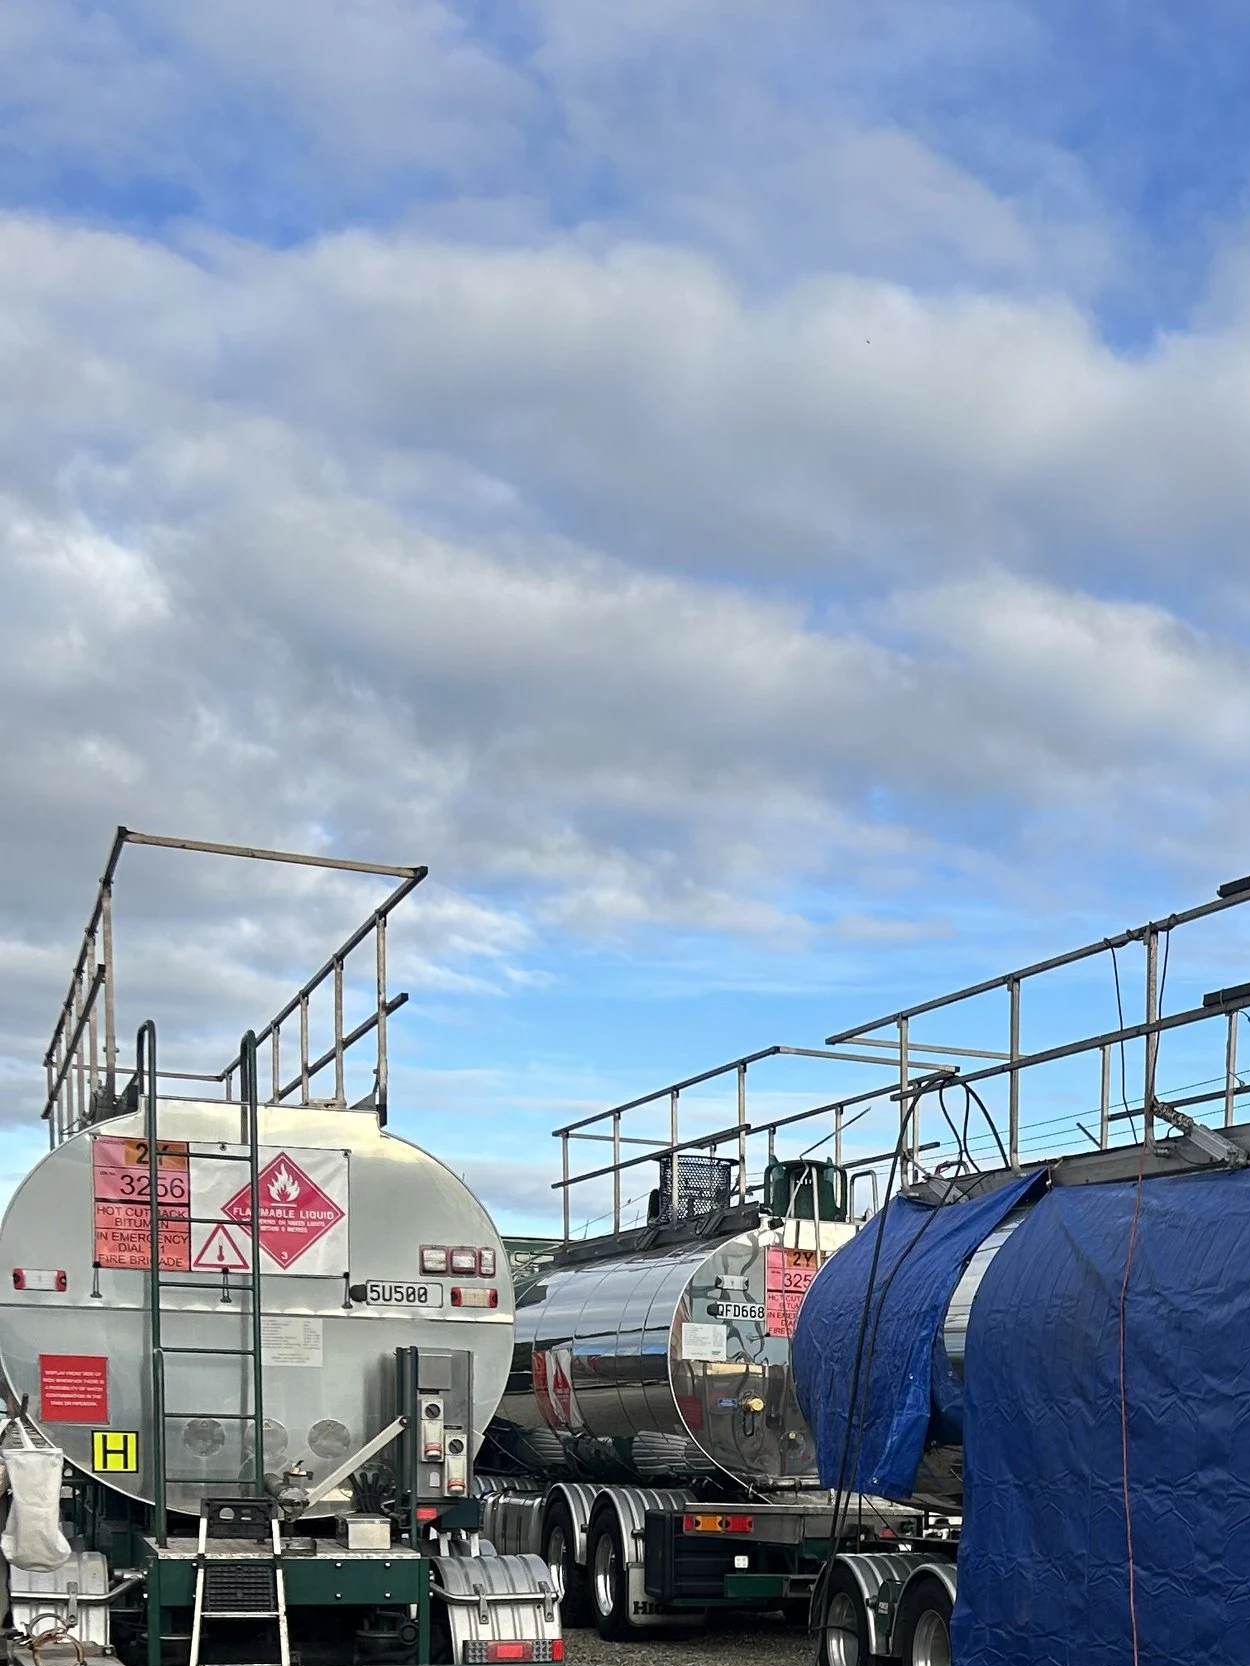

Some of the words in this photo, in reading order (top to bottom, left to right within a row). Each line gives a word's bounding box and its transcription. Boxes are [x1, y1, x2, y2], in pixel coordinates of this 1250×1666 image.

[120, 1175, 185, 1198] 3256
[97, 1206, 122, 1215] HOT
[125, 1207, 187, 1218] CUTACK
[233, 1208, 295, 1219] FLAMABLE
[300, 1210, 334, 1220] LIQUID
[115, 1218, 169, 1229] BITUMN
[96, 1231, 108, 1241] IN
[118, 1243, 145, 1253] DIAL
[98, 1254, 126, 1264] FIRE
[129, 1255, 183, 1267] BRIADE
[281, 1251, 288, 1260] 3
[793, 1252, 814, 1267] 2Y
[784, 1273, 812, 1288] 325
[370, 1284, 428, 1303] 5U500
[102, 1434, 128, 1469] H
